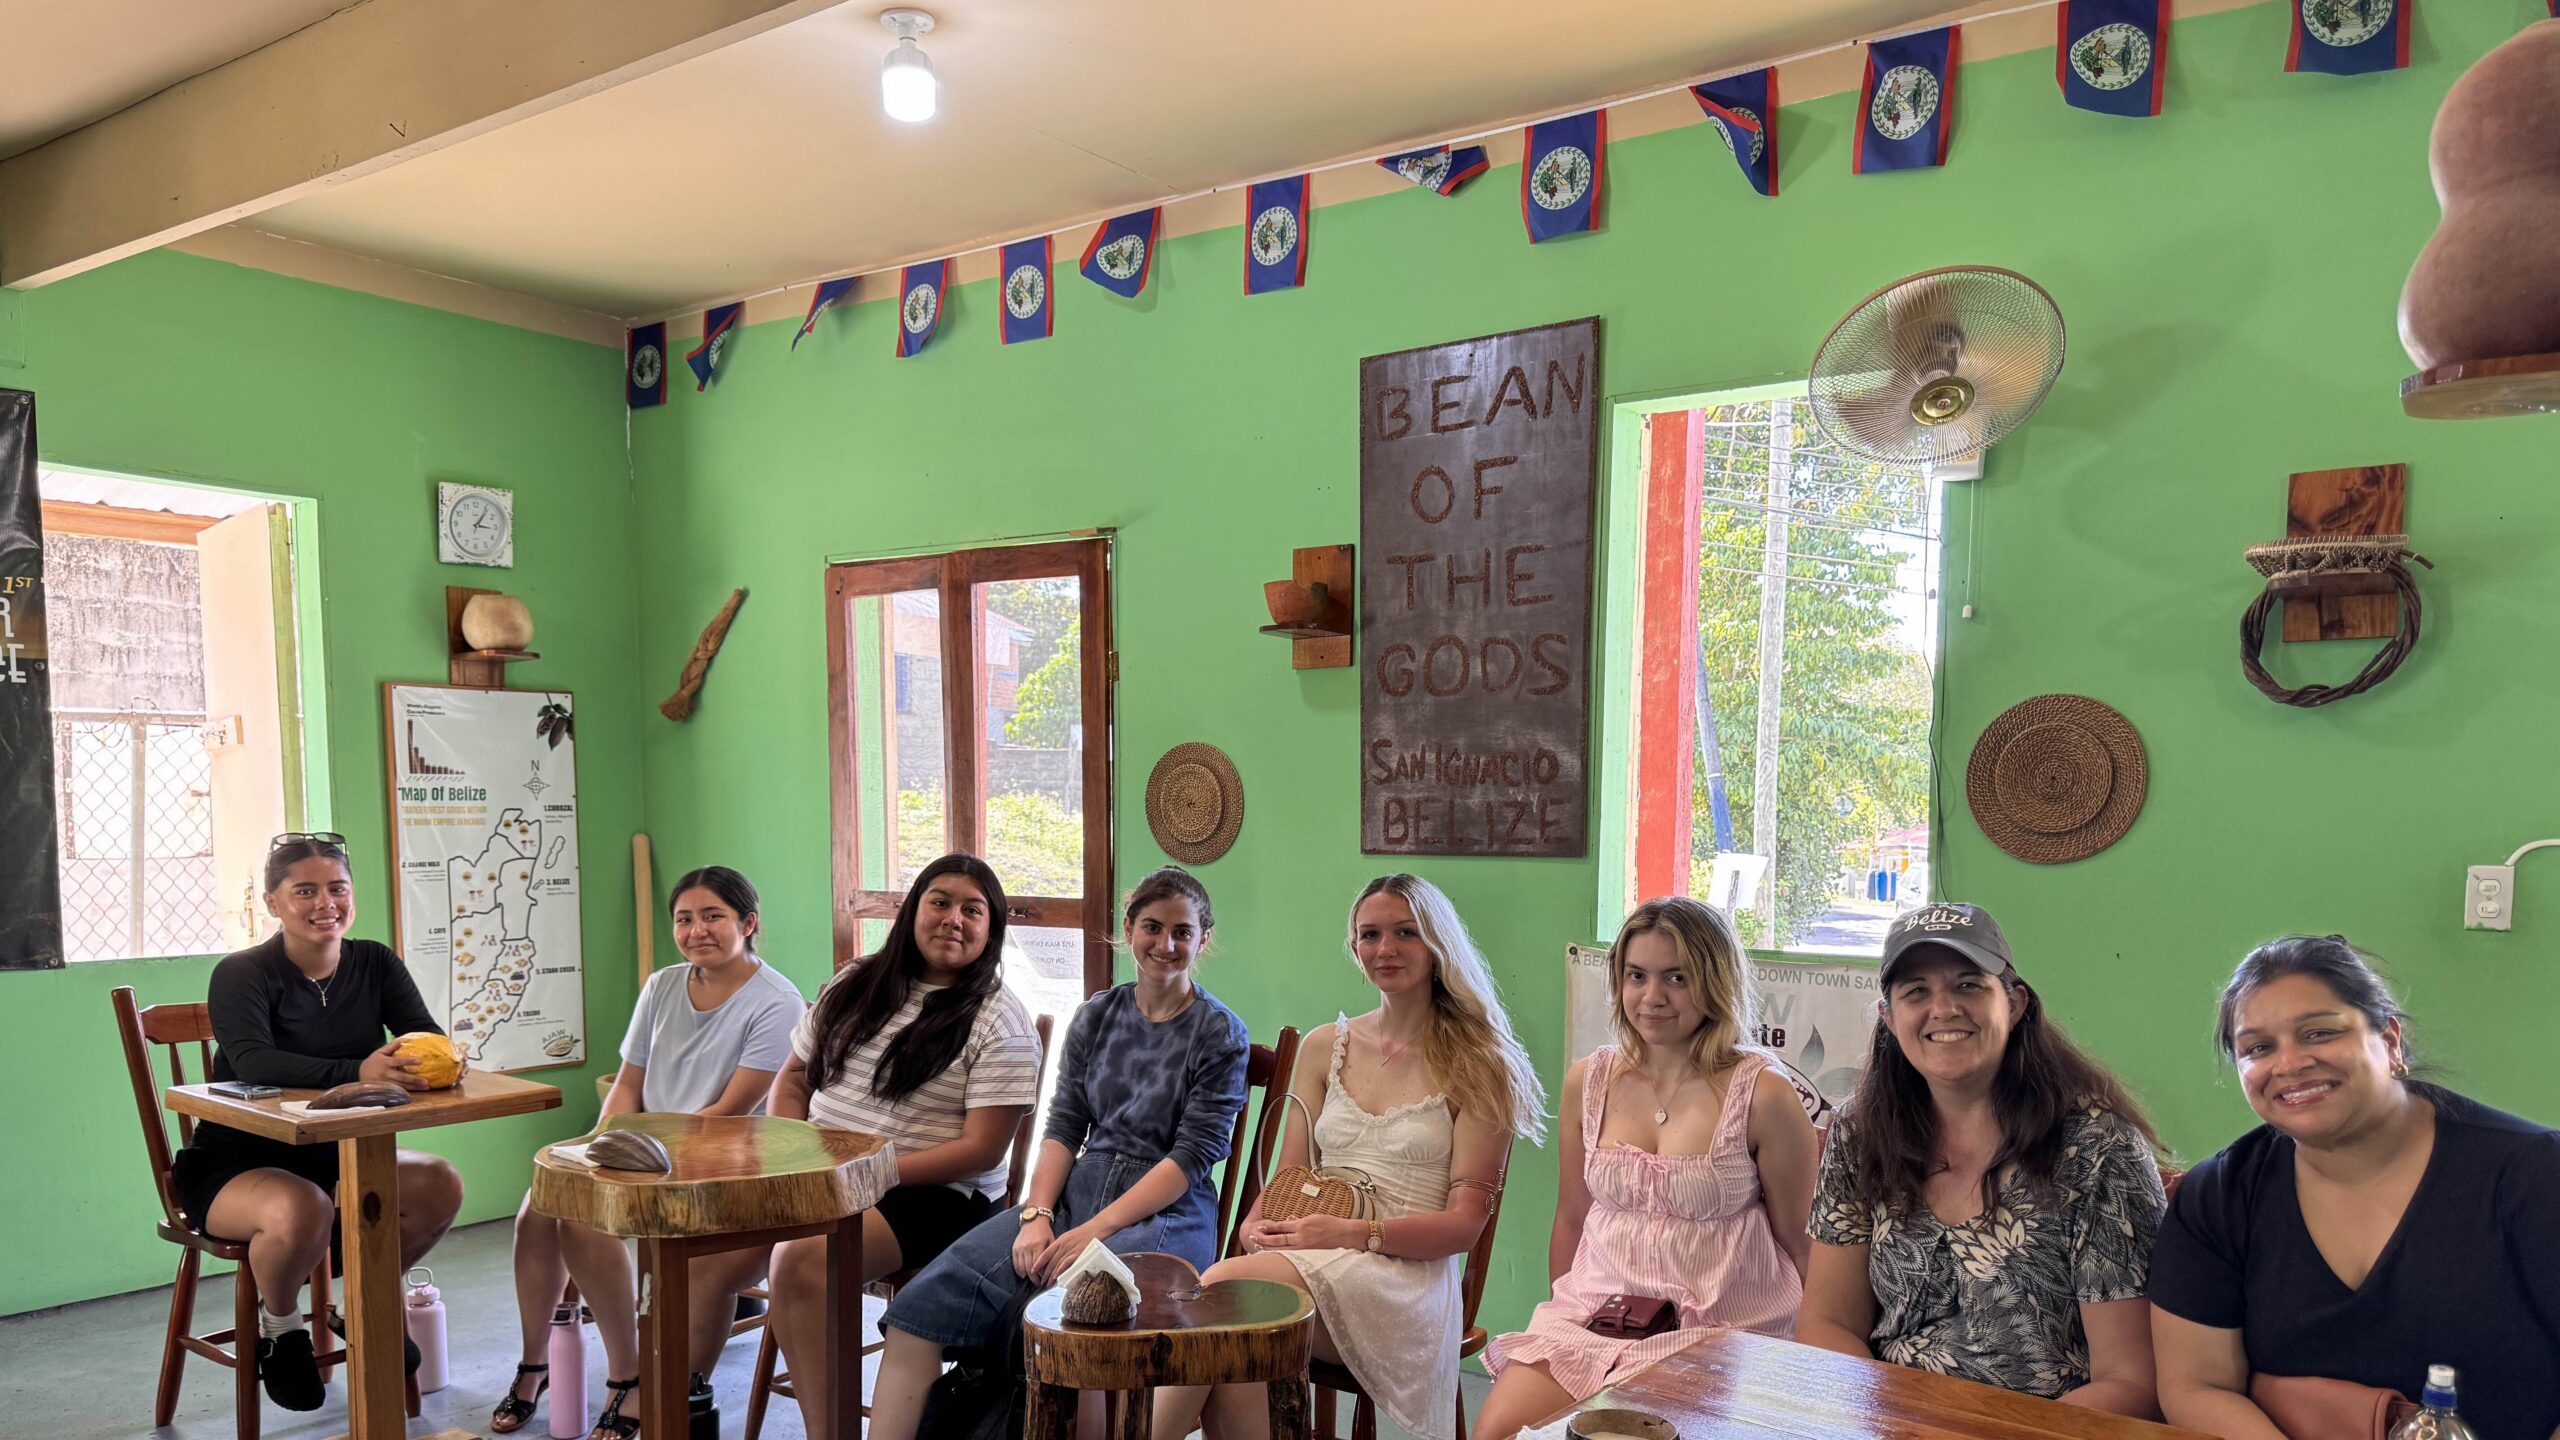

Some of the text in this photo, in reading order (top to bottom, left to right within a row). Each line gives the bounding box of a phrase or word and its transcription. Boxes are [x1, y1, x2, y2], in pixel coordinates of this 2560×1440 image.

[1376, 352, 1585, 442] BEAN
[1411, 455, 1518, 524] OF
[1387, 544, 1554, 610] THE
[1377, 633, 1569, 697] GODS
[531, 759, 540, 771] N
[401, 785, 487, 803] Map Of Belize
[1383, 795, 1572, 849] BELIZE
[1904, 909, 1974, 932] Belize
[1758, 967, 1802, 984] DOWN
[1807, 971, 1850, 988] TOWN
[1752, 1023, 1786, 1048] te
